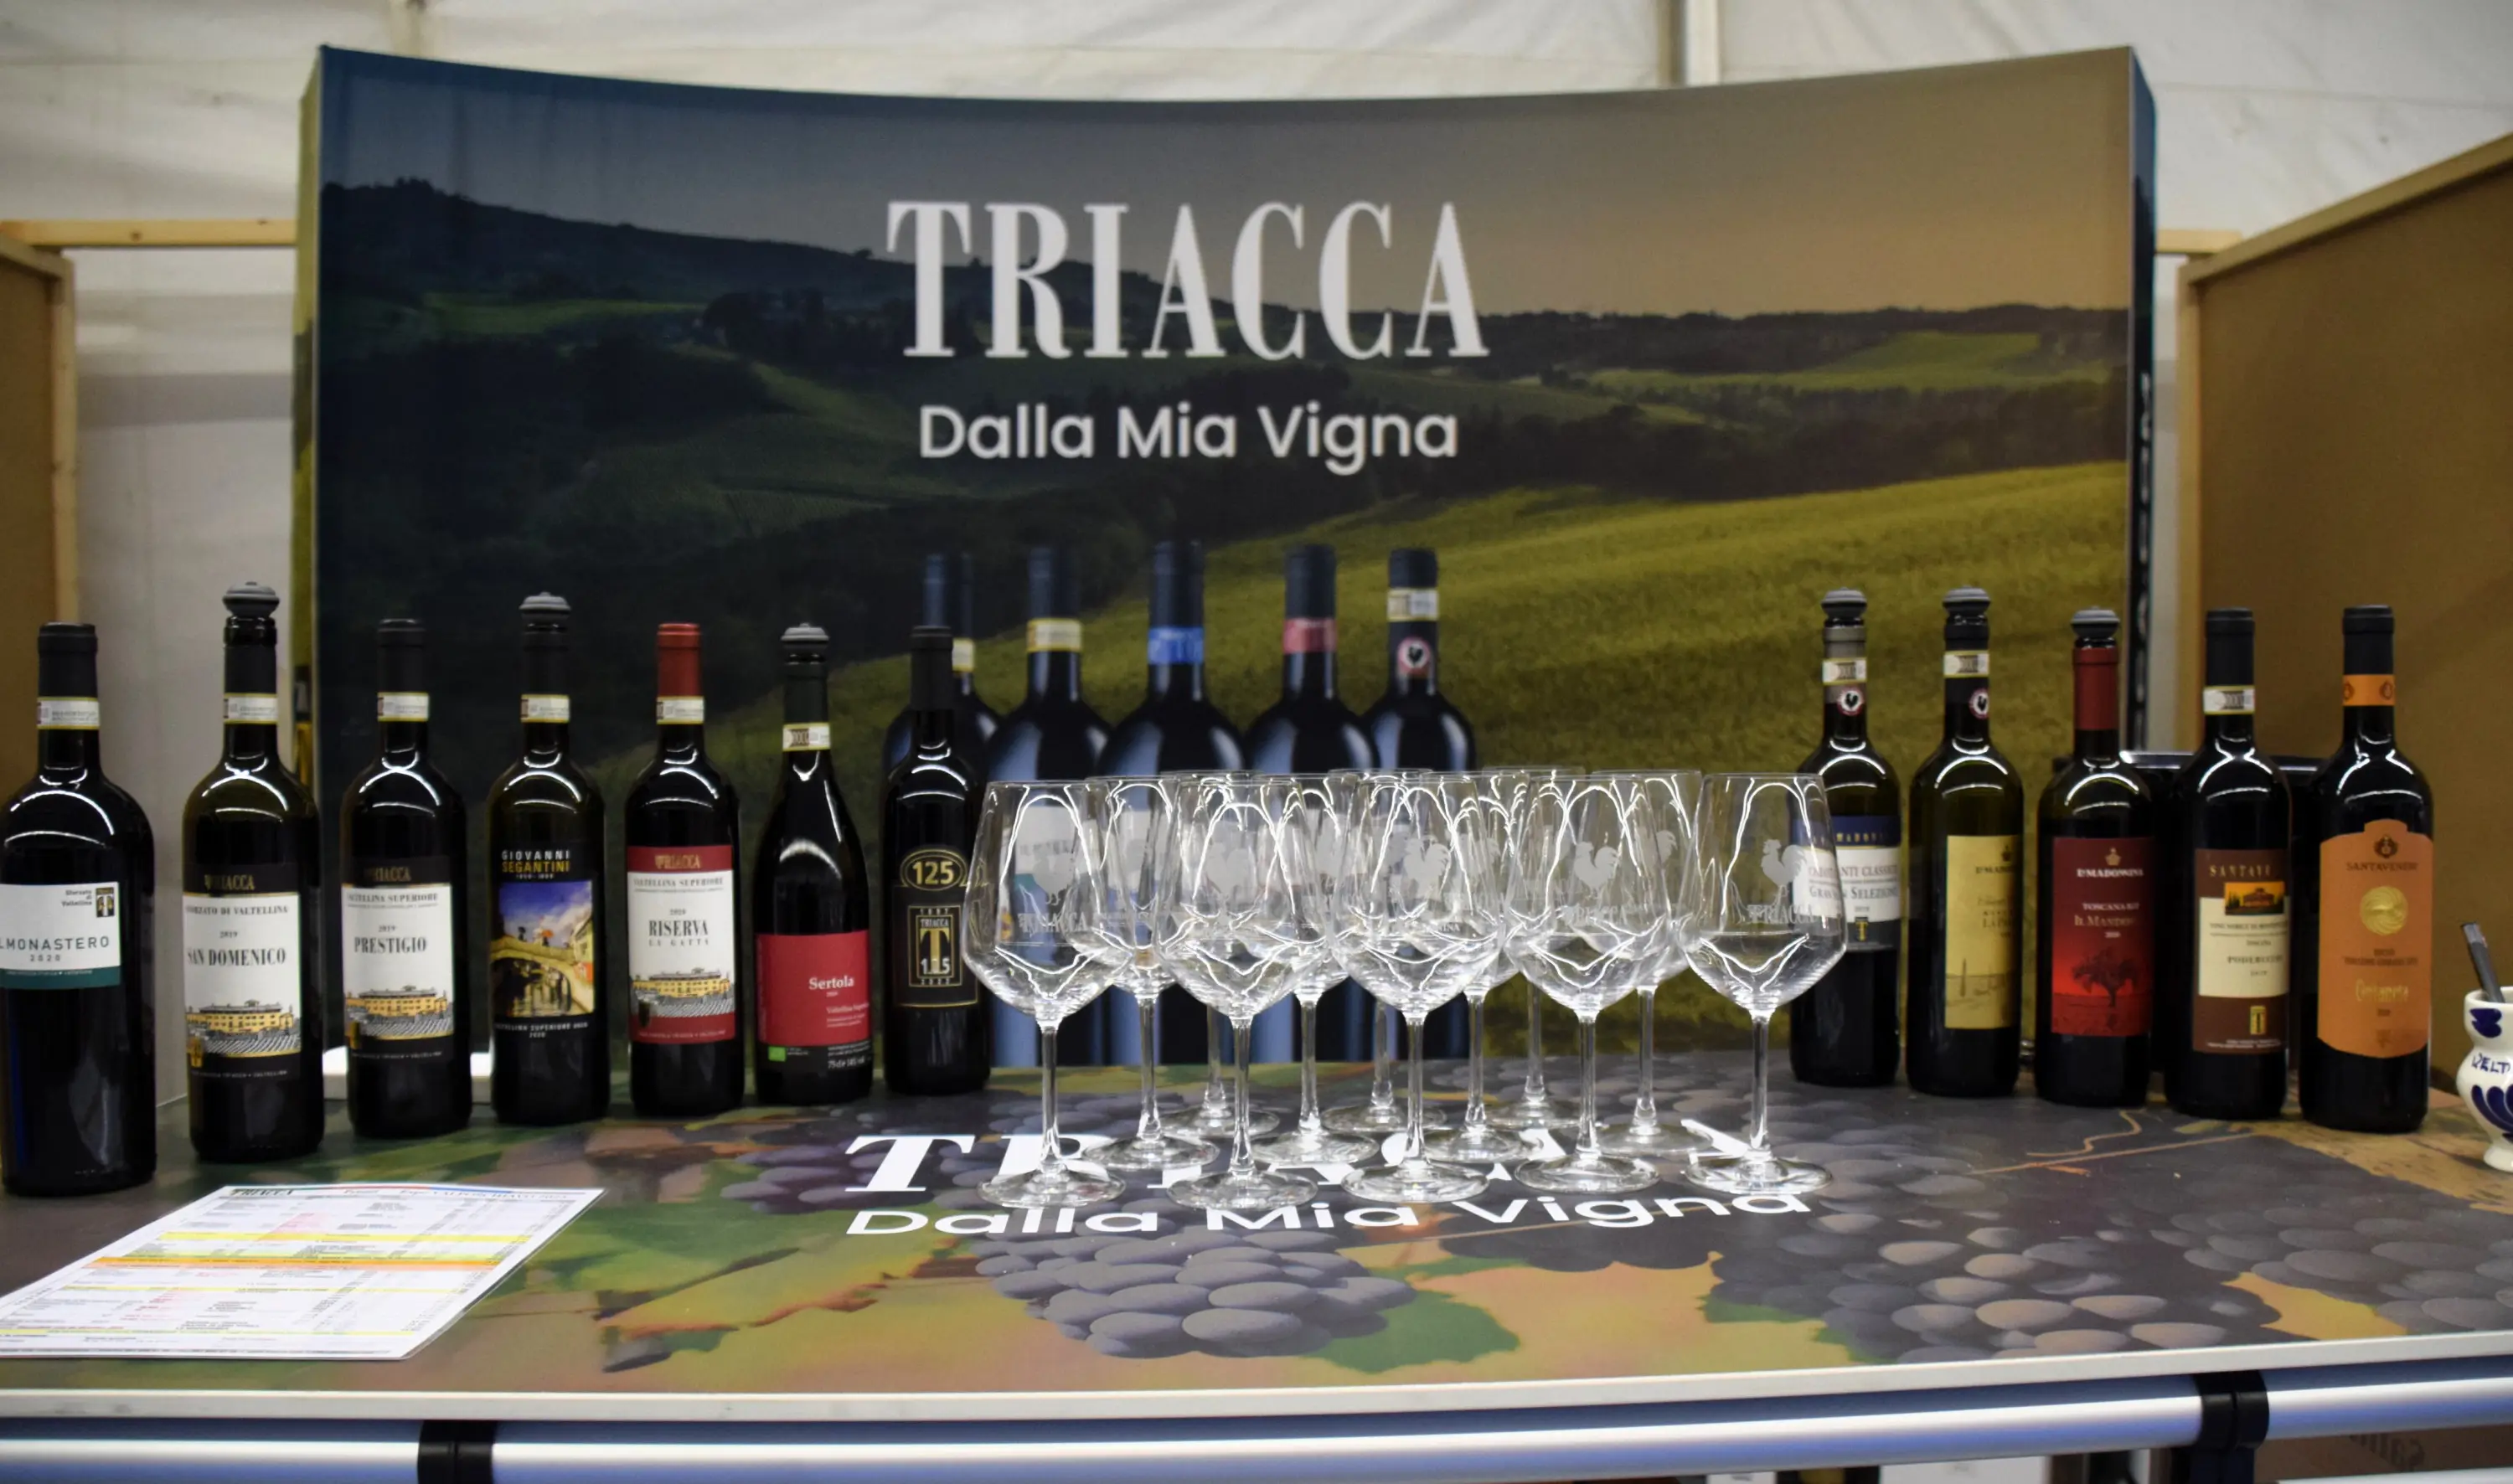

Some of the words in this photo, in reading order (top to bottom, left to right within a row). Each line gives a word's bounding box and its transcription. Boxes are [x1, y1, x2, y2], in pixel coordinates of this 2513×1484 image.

[886, 201, 1491, 360] TRIACCA
[920, 403, 1094, 459] Dalla
[1117, 401, 1237, 459] Mia
[1256, 400, 1459, 477] Vigna
[501, 850, 570, 861] GIOVANNI
[501, 861, 571, 873] SEGANTINI
[912, 861, 955, 885] 125
[219, 907, 231, 915] DI
[234, 905, 288, 915] VALTELLINA
[648, 920, 709, 937] RISERVA
[354, 936, 426, 954] PRESTIGIO
[30, 954, 62, 962] 2020
[188, 948, 205, 966] SAN
[207, 948, 287, 966] DOMENICO
[808, 976, 855, 991] Sertola
[845, 1206, 1158, 1235] Dalla
[1206, 1196, 1420, 1235] Mia
[1451, 1193, 1811, 1229] Vigna
